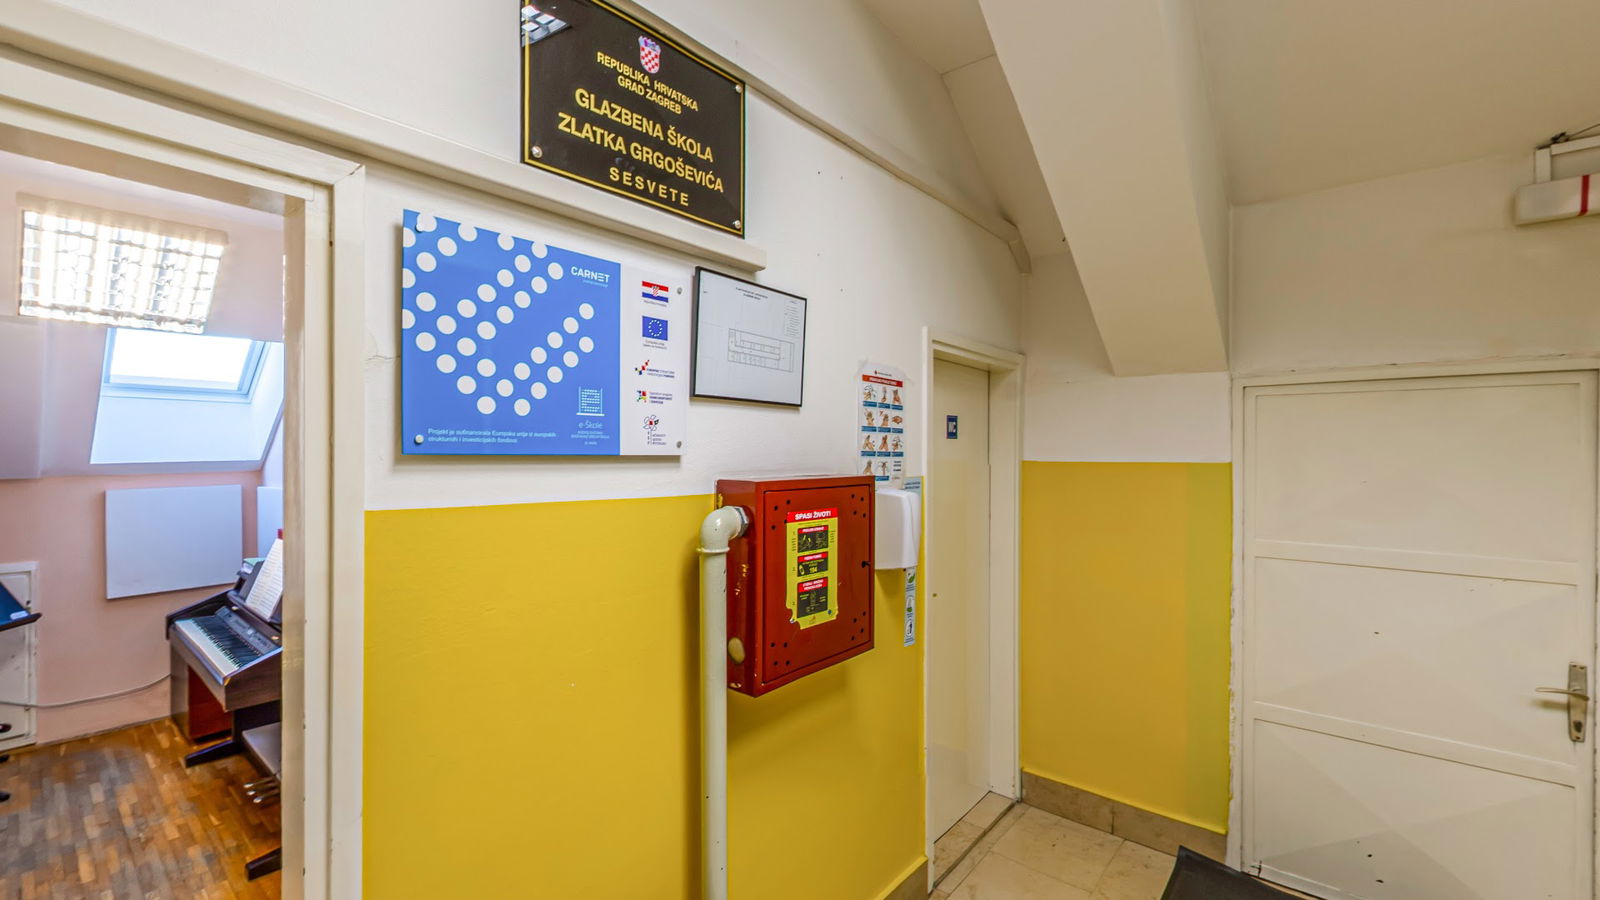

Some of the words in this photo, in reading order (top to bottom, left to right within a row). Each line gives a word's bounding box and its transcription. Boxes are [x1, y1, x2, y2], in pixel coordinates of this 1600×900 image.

[597, 51, 650, 87] REPUBLIKA
[654, 80, 699, 112] HRVATSKA
[617, 75, 645, 96] GRAD
[646, 89, 682, 115] ZAGREB
[575, 88, 664, 141] GLAZBENA
[667, 125, 714, 163] ŠKOLA
[558, 112, 627, 155] ZLATKA
[630, 142, 724, 193] GRGOŠEVIĆA
[609, 167, 689, 206] SESVETE
[571, 266, 610, 283] CARNET
[948, 421, 957, 433] WC
[795, 512, 812, 520] SPASI
